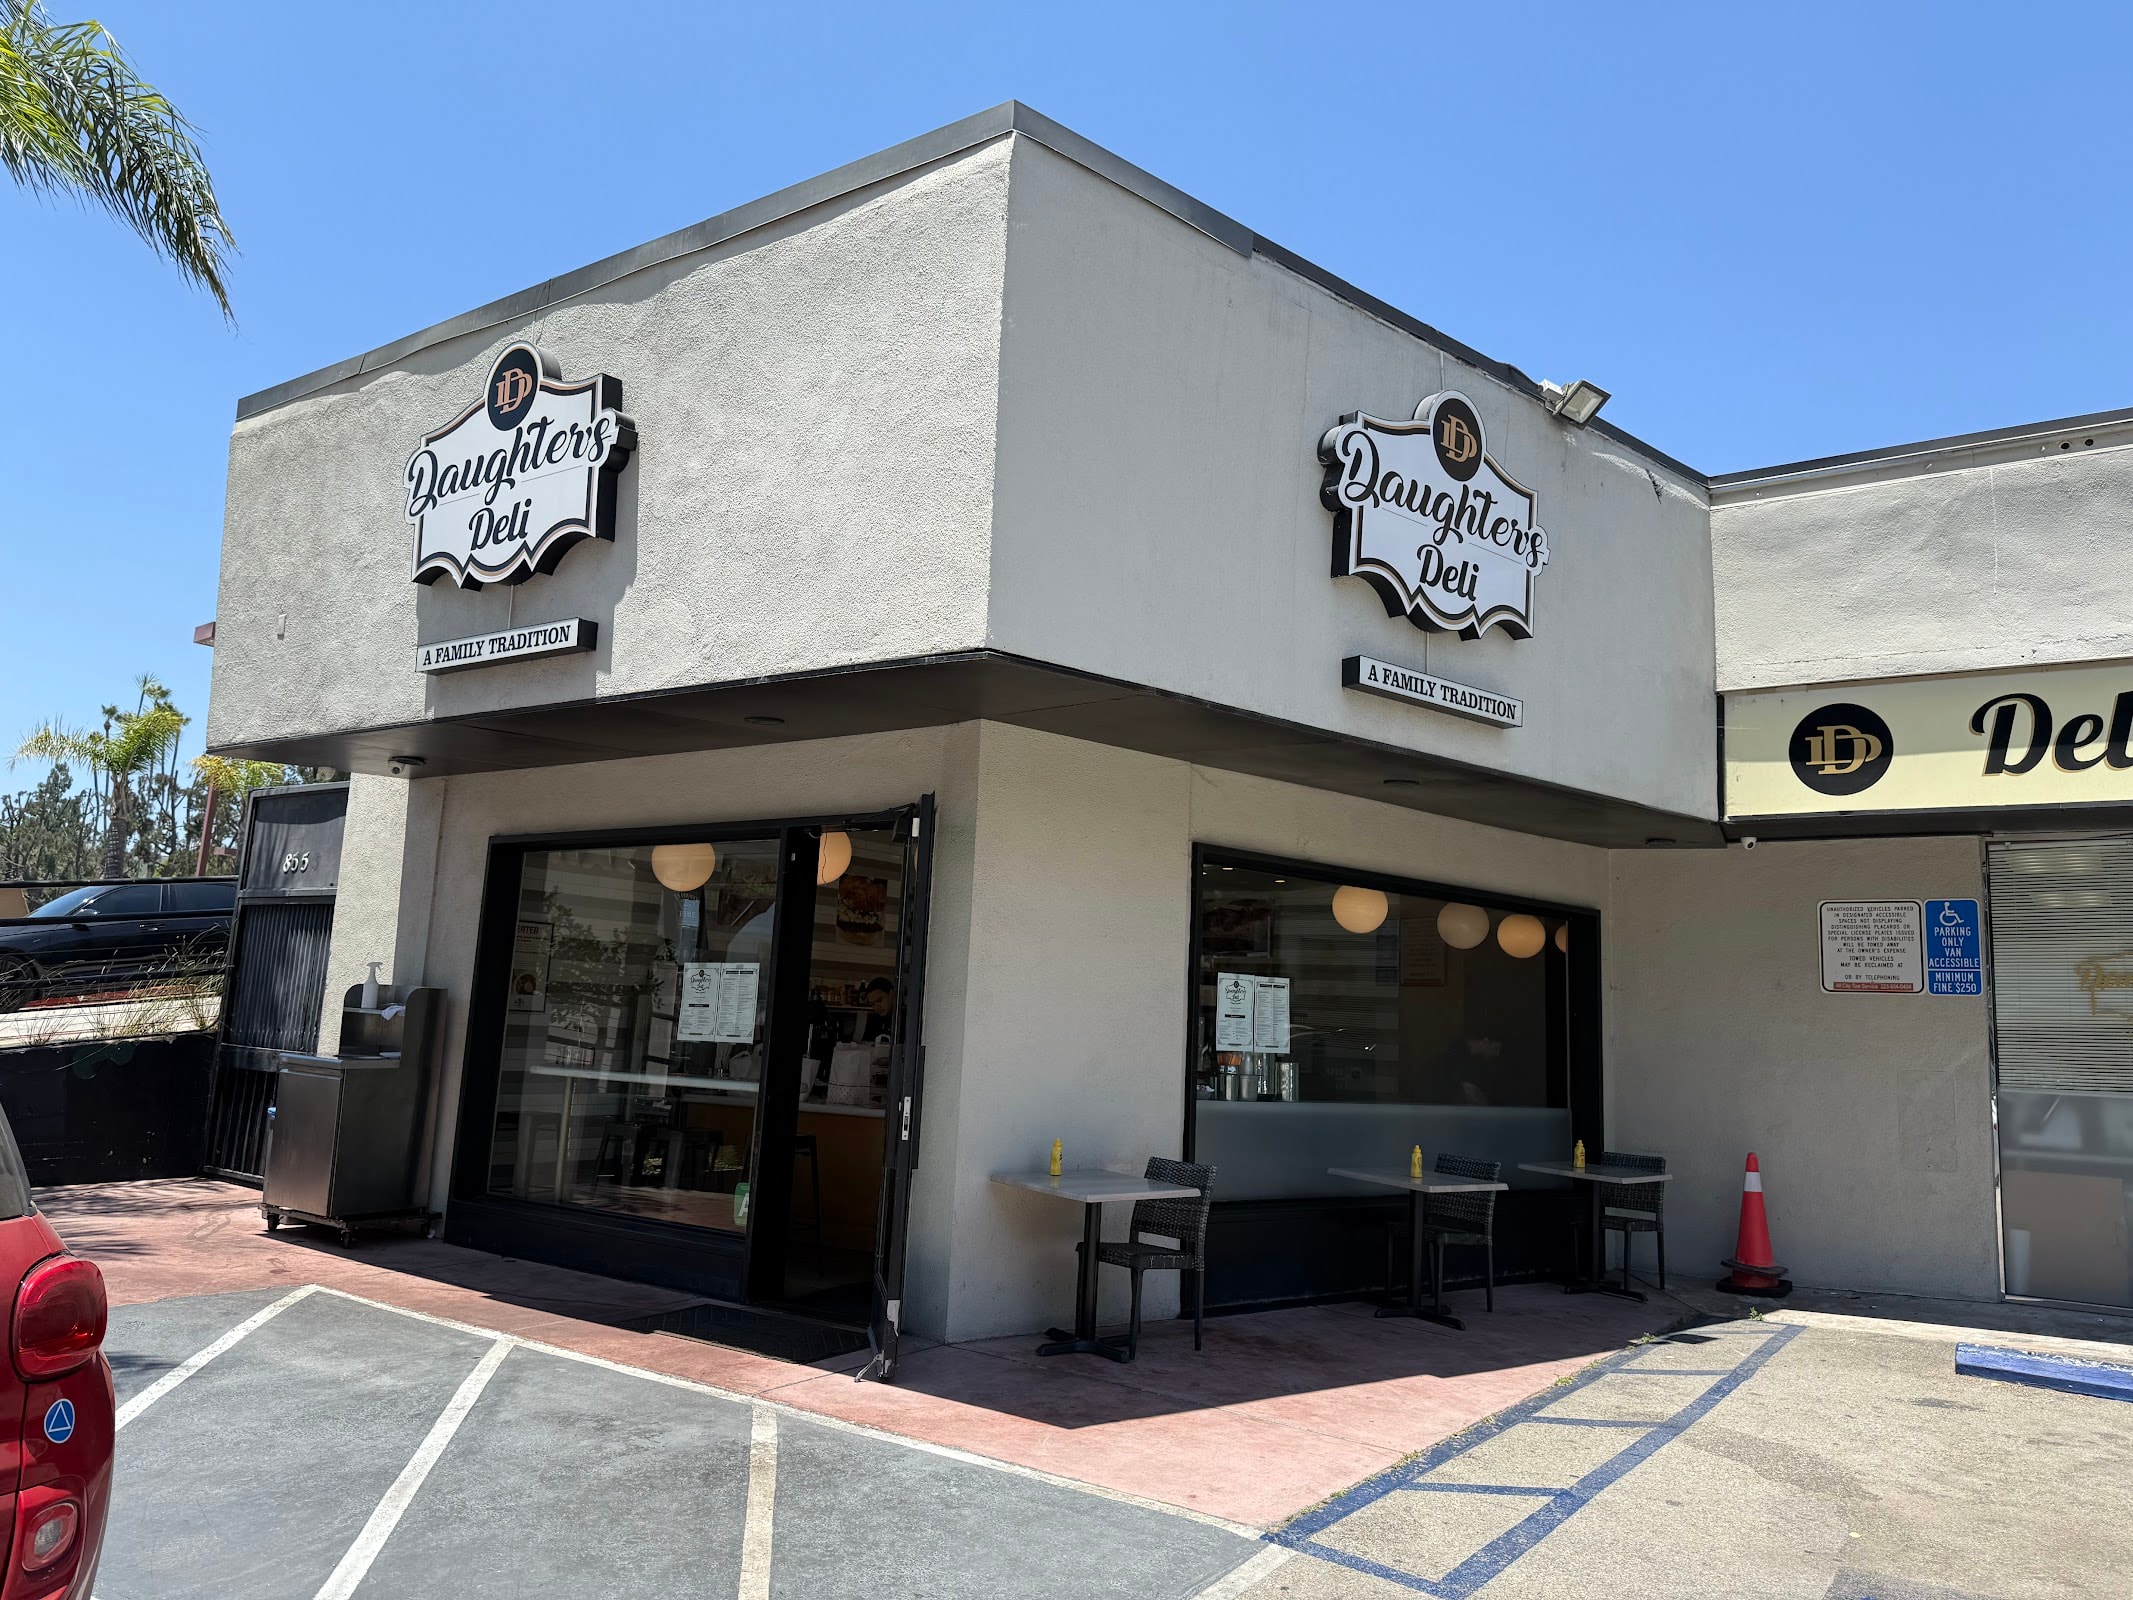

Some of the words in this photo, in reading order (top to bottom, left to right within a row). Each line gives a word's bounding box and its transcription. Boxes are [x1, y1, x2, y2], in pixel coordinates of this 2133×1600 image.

[408, 416, 612, 517] Daughter's
[1341, 430, 1546, 568] Daughter's
[468, 498, 532, 551] Deli
[1416, 544, 1480, 601] Deli
[422, 650, 432, 666] A
[435, 639, 485, 664] FAMILY
[488, 625, 571, 654] TRADITION
[1367, 664, 1379, 682] A
[1382, 668, 1437, 698] FAMILY
[1440, 685, 1517, 720] TRADITION
[283, 851, 310, 873] 855
[1934, 927, 1971, 937] PARKING
[1941, 937, 1964, 947] ONLY
[1928, 958, 1979, 968] ACCESSIBLE
[1944, 948, 1962, 957] VAN
[1933, 983, 1953, 993] FINE
[1955, 983, 1977, 993] $250
[1935, 972, 1974, 982] MINIMUM
